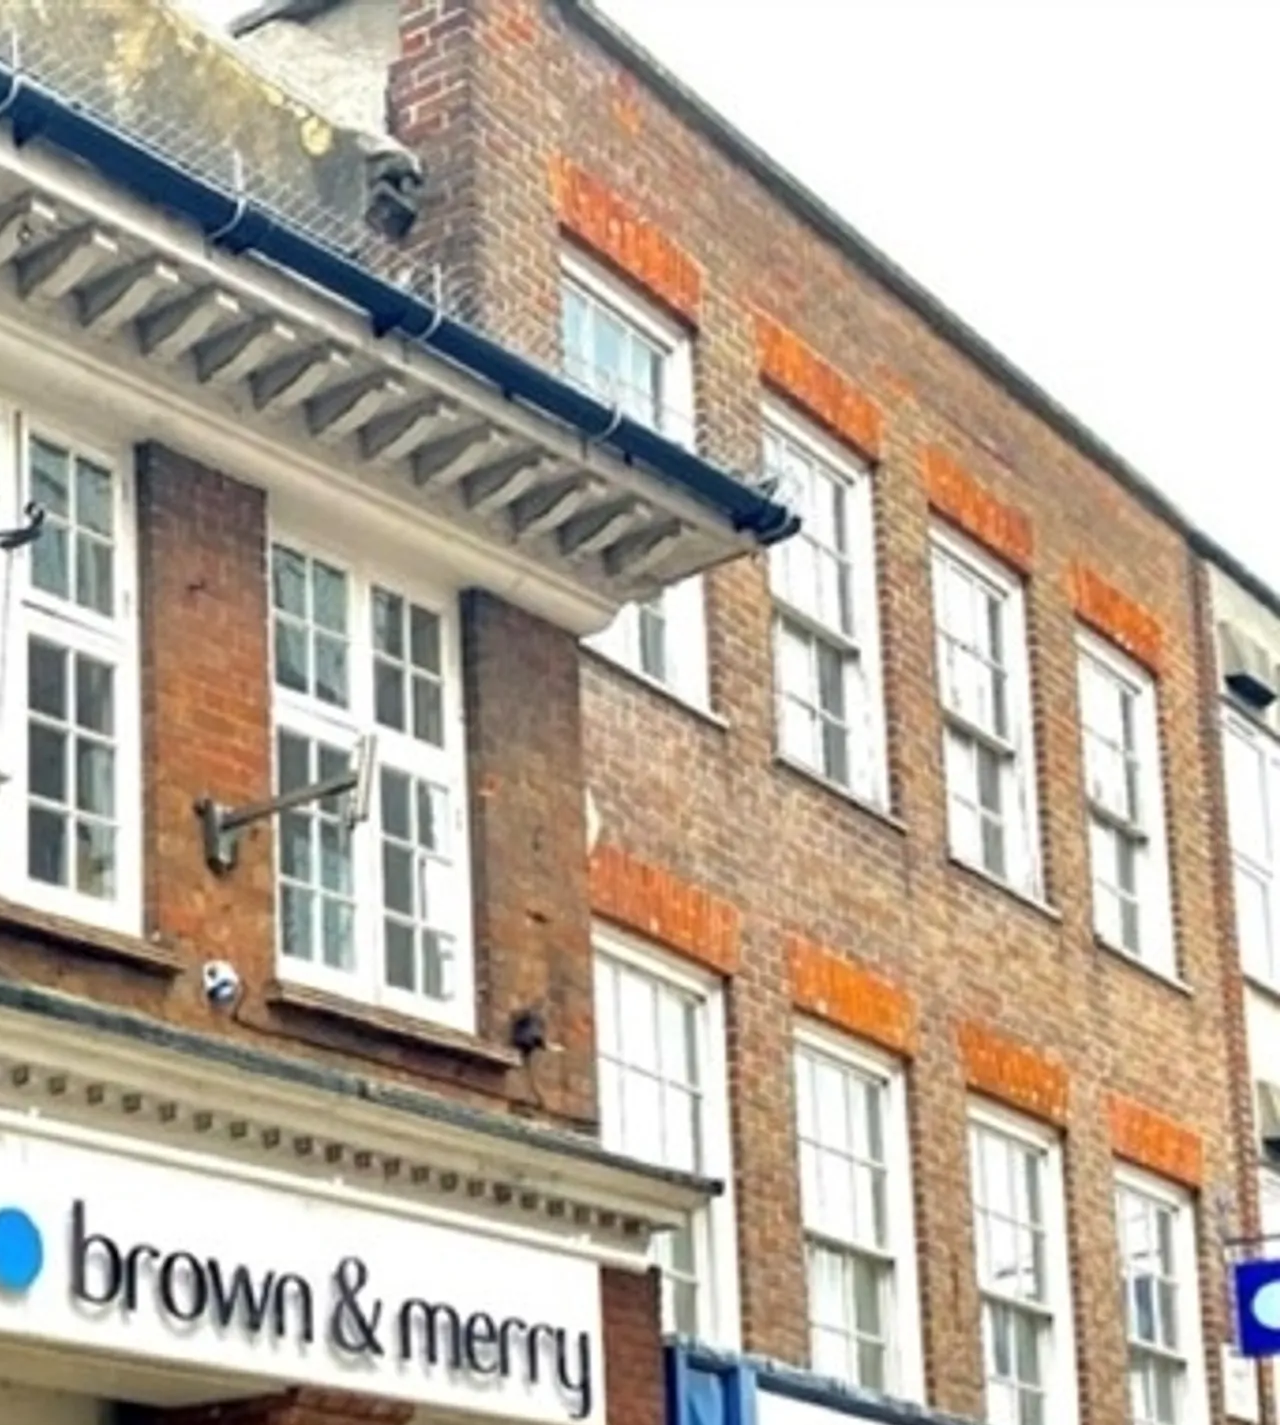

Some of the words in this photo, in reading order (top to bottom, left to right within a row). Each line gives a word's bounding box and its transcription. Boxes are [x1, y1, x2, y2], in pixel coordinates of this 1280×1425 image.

[71, 1199, 313, 1342] brown
[331, 1257, 382, 1354] &
[400, 1295, 591, 1418] merry
